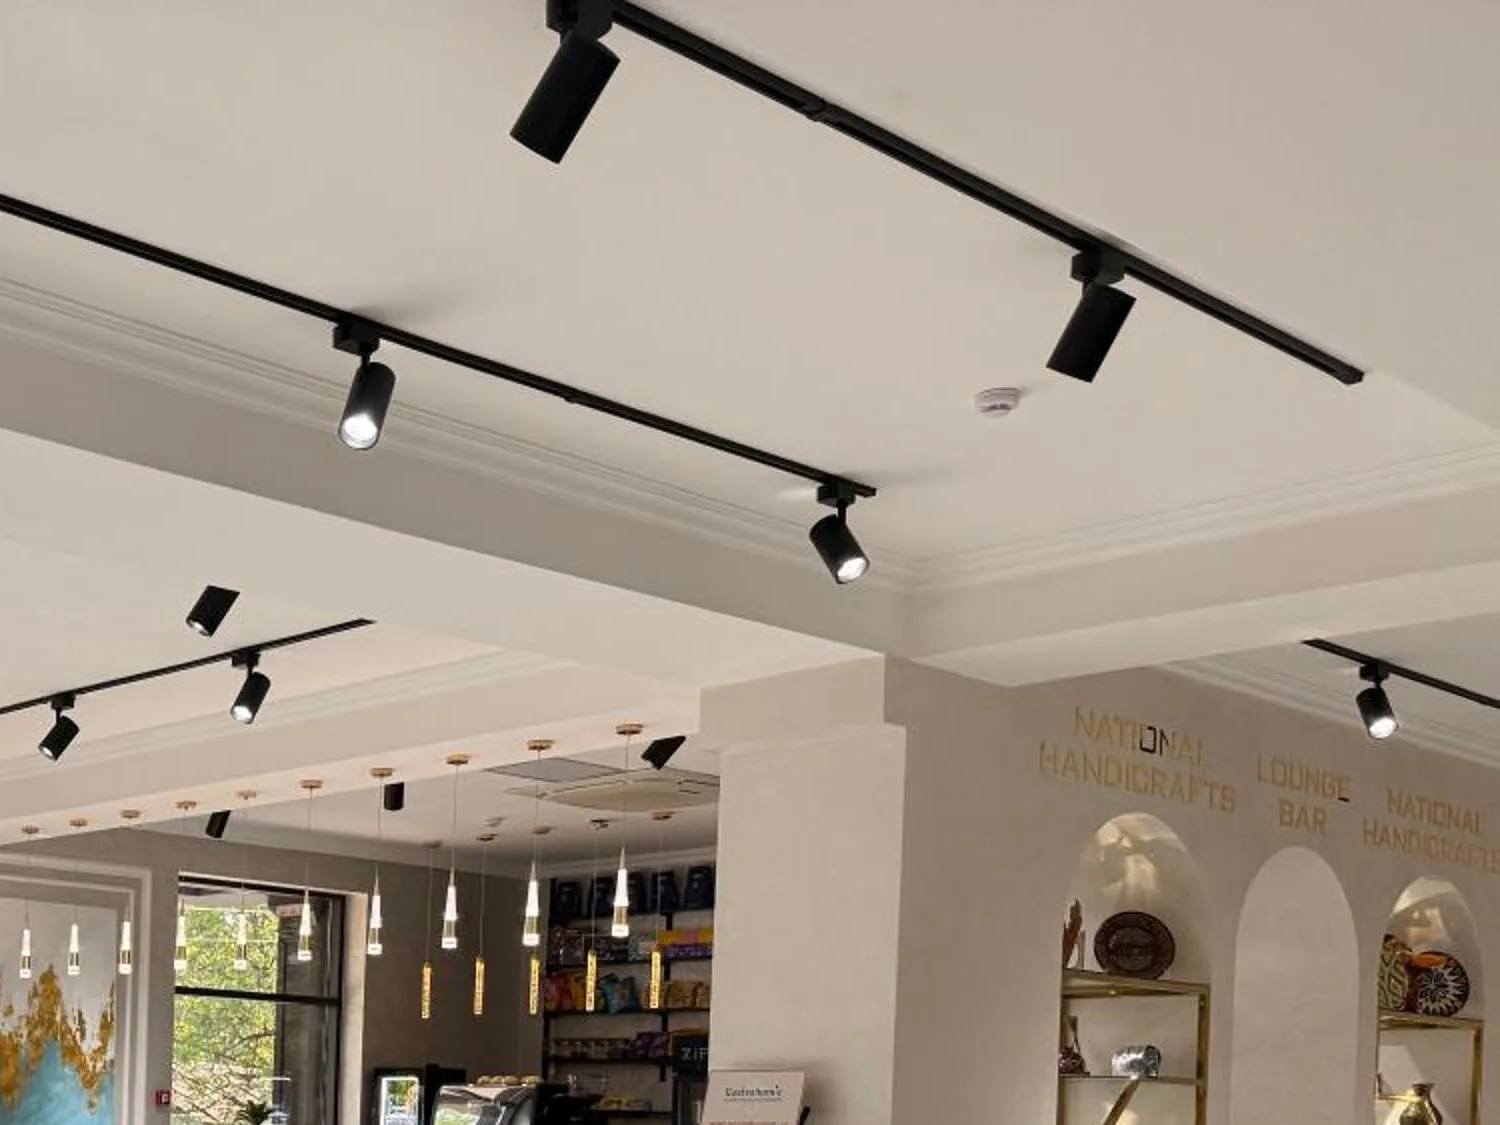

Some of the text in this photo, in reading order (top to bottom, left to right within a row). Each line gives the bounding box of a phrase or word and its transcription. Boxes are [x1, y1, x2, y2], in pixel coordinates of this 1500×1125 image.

[1074, 705, 1208, 767] NATIONAL
[1038, 742, 1238, 813] HANDICRAFTS
[1257, 752, 1351, 803] LOUNGE
[1279, 797, 1328, 836] BAR
[1386, 786, 1485, 836] NATIONAL
